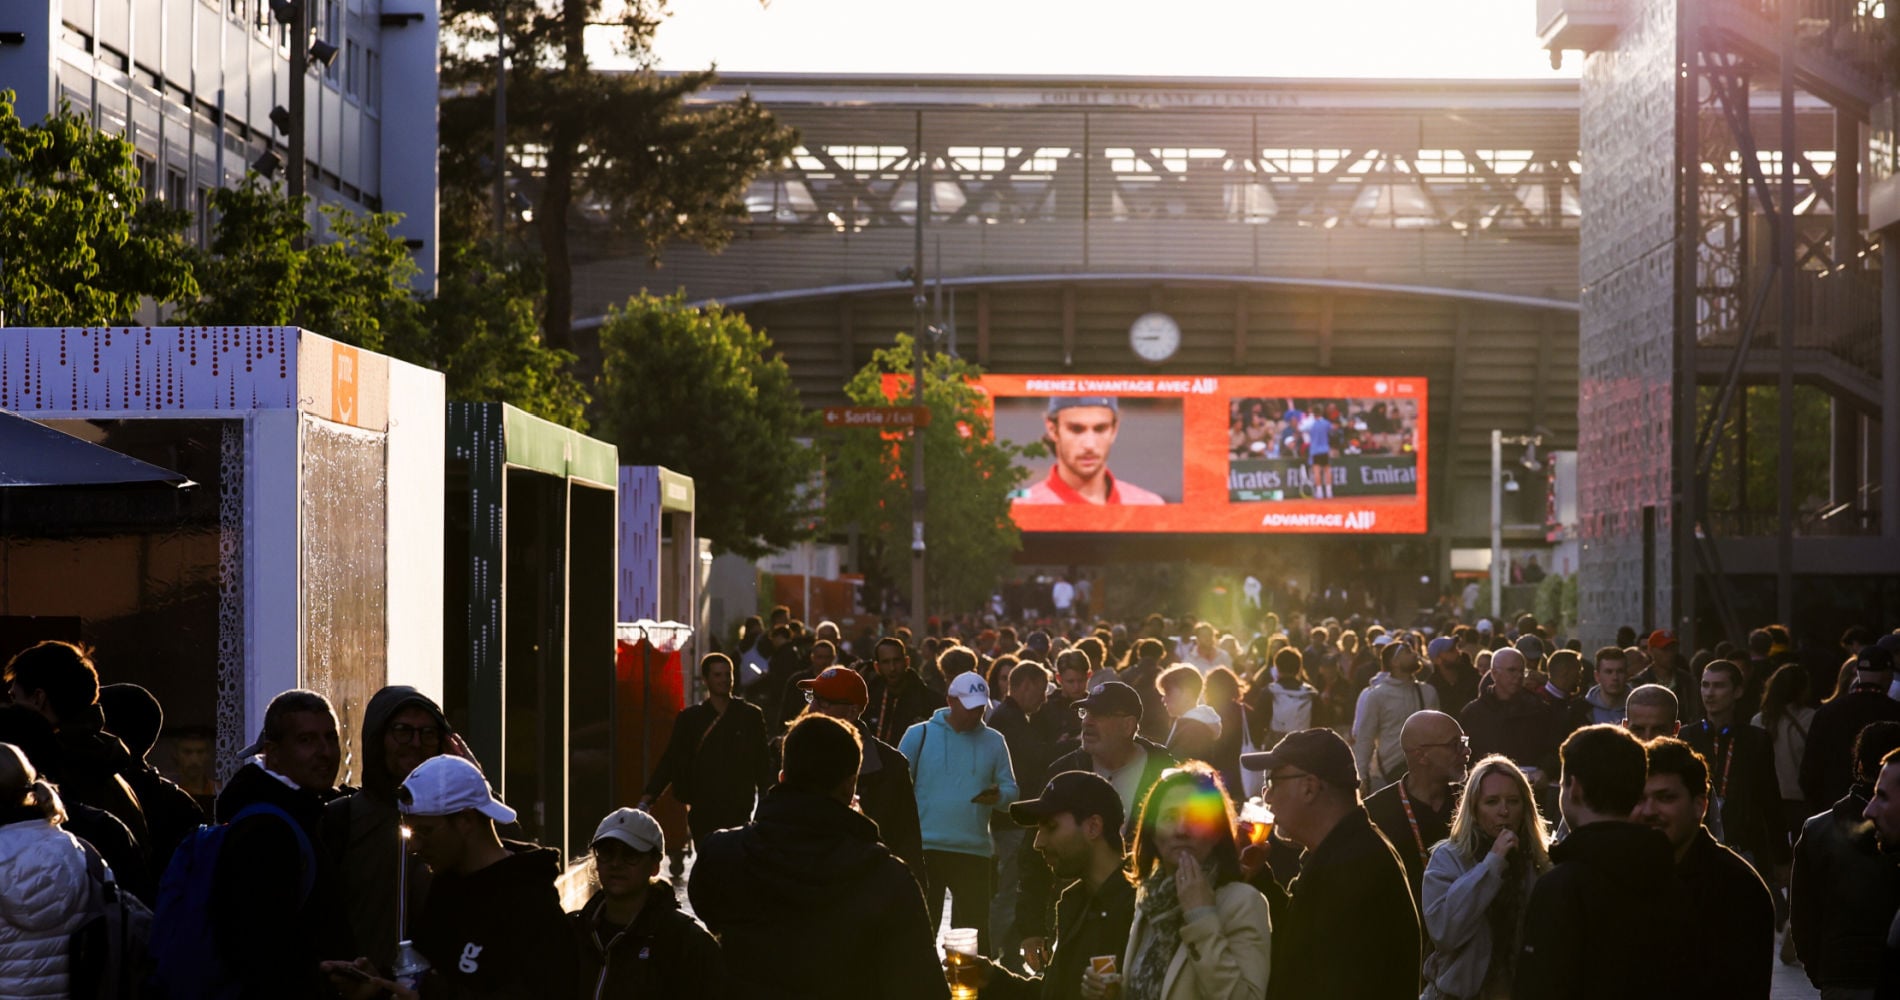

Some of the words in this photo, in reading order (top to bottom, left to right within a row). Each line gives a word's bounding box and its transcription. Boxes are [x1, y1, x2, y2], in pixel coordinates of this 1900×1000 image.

[1026, 380, 1076, 392] PRENEZ
[1078, 380, 1154, 392] L'AVANTAGE
[1157, 380, 1189, 392] AVEC
[845, 410, 883, 424] Sortie
[893, 411, 914, 423] Exit
[1262, 514, 1343, 526] ADVANTAGE
